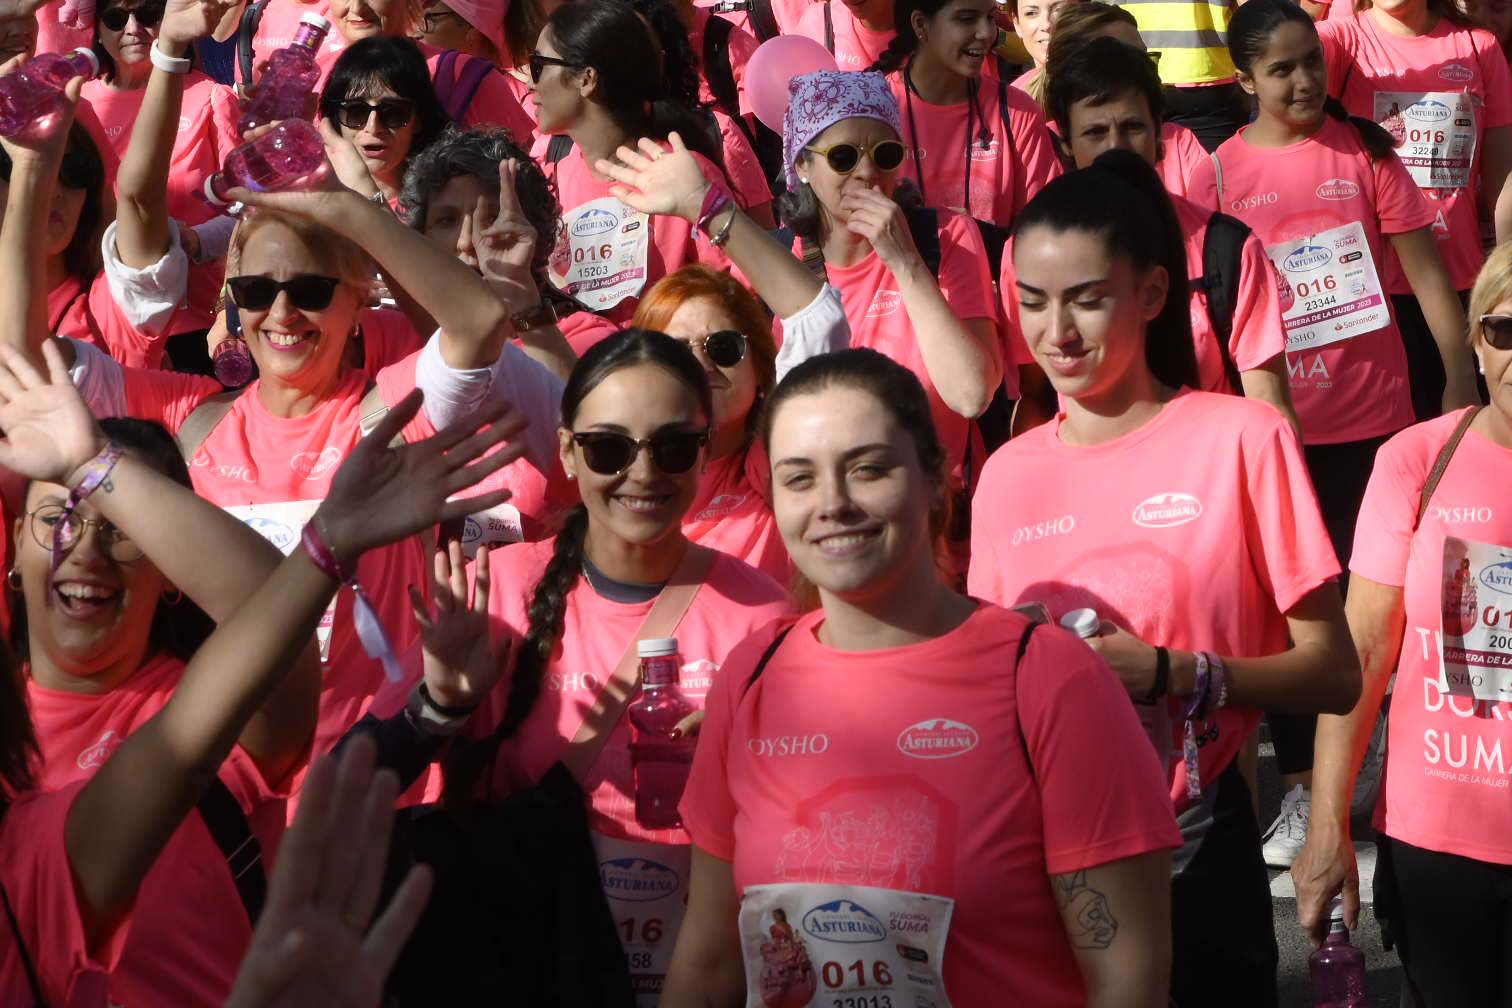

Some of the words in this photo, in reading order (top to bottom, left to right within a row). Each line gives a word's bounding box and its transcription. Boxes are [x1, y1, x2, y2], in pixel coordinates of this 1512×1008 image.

[1407, 107, 1448, 117] ASTURIANA
[1409, 129, 1445, 143] 016
[1231, 191, 1279, 212] OYSHO
[575, 219, 615, 233] ASTURIANA
[574, 244, 613, 264] 016
[1286, 252, 1330, 268] ASTURIANA
[577, 265, 609, 278] 15203
[1296, 274, 1337, 298] 016
[1305, 295, 1337, 311] 23344
[1284, 316, 1311, 329] ARRERA
[1311, 313, 1322, 323] DE
[1322, 311, 1332, 320] LA
[1332, 304, 1356, 319] MUJER
[1356, 299, 1373, 309] 2023
[1343, 312, 1380, 329] Santander
[1287, 353, 1330, 379] MA
[1137, 503, 1197, 523] ASTURIANA
[1429, 506, 1493, 523] OYSHO
[1011, 515, 1076, 546] OYSHO
[1486, 655, 1501, 666] DE
[543, 671, 599, 691] SHO
[748, 734, 830, 757] OYSHO
[903, 733, 972, 751] ASTURIANA
[1424, 767, 1457, 782] CARRERA
[1458, 773, 1471, 783] DE
[1471, 774, 1482, 784] LA
[1482, 775, 1510, 788] MUJER
[620, 917, 664, 943] 16
[811, 916, 882, 935] ASTURIANA
[888, 919, 929, 934] SUMA
[822, 959, 894, 989] 016
